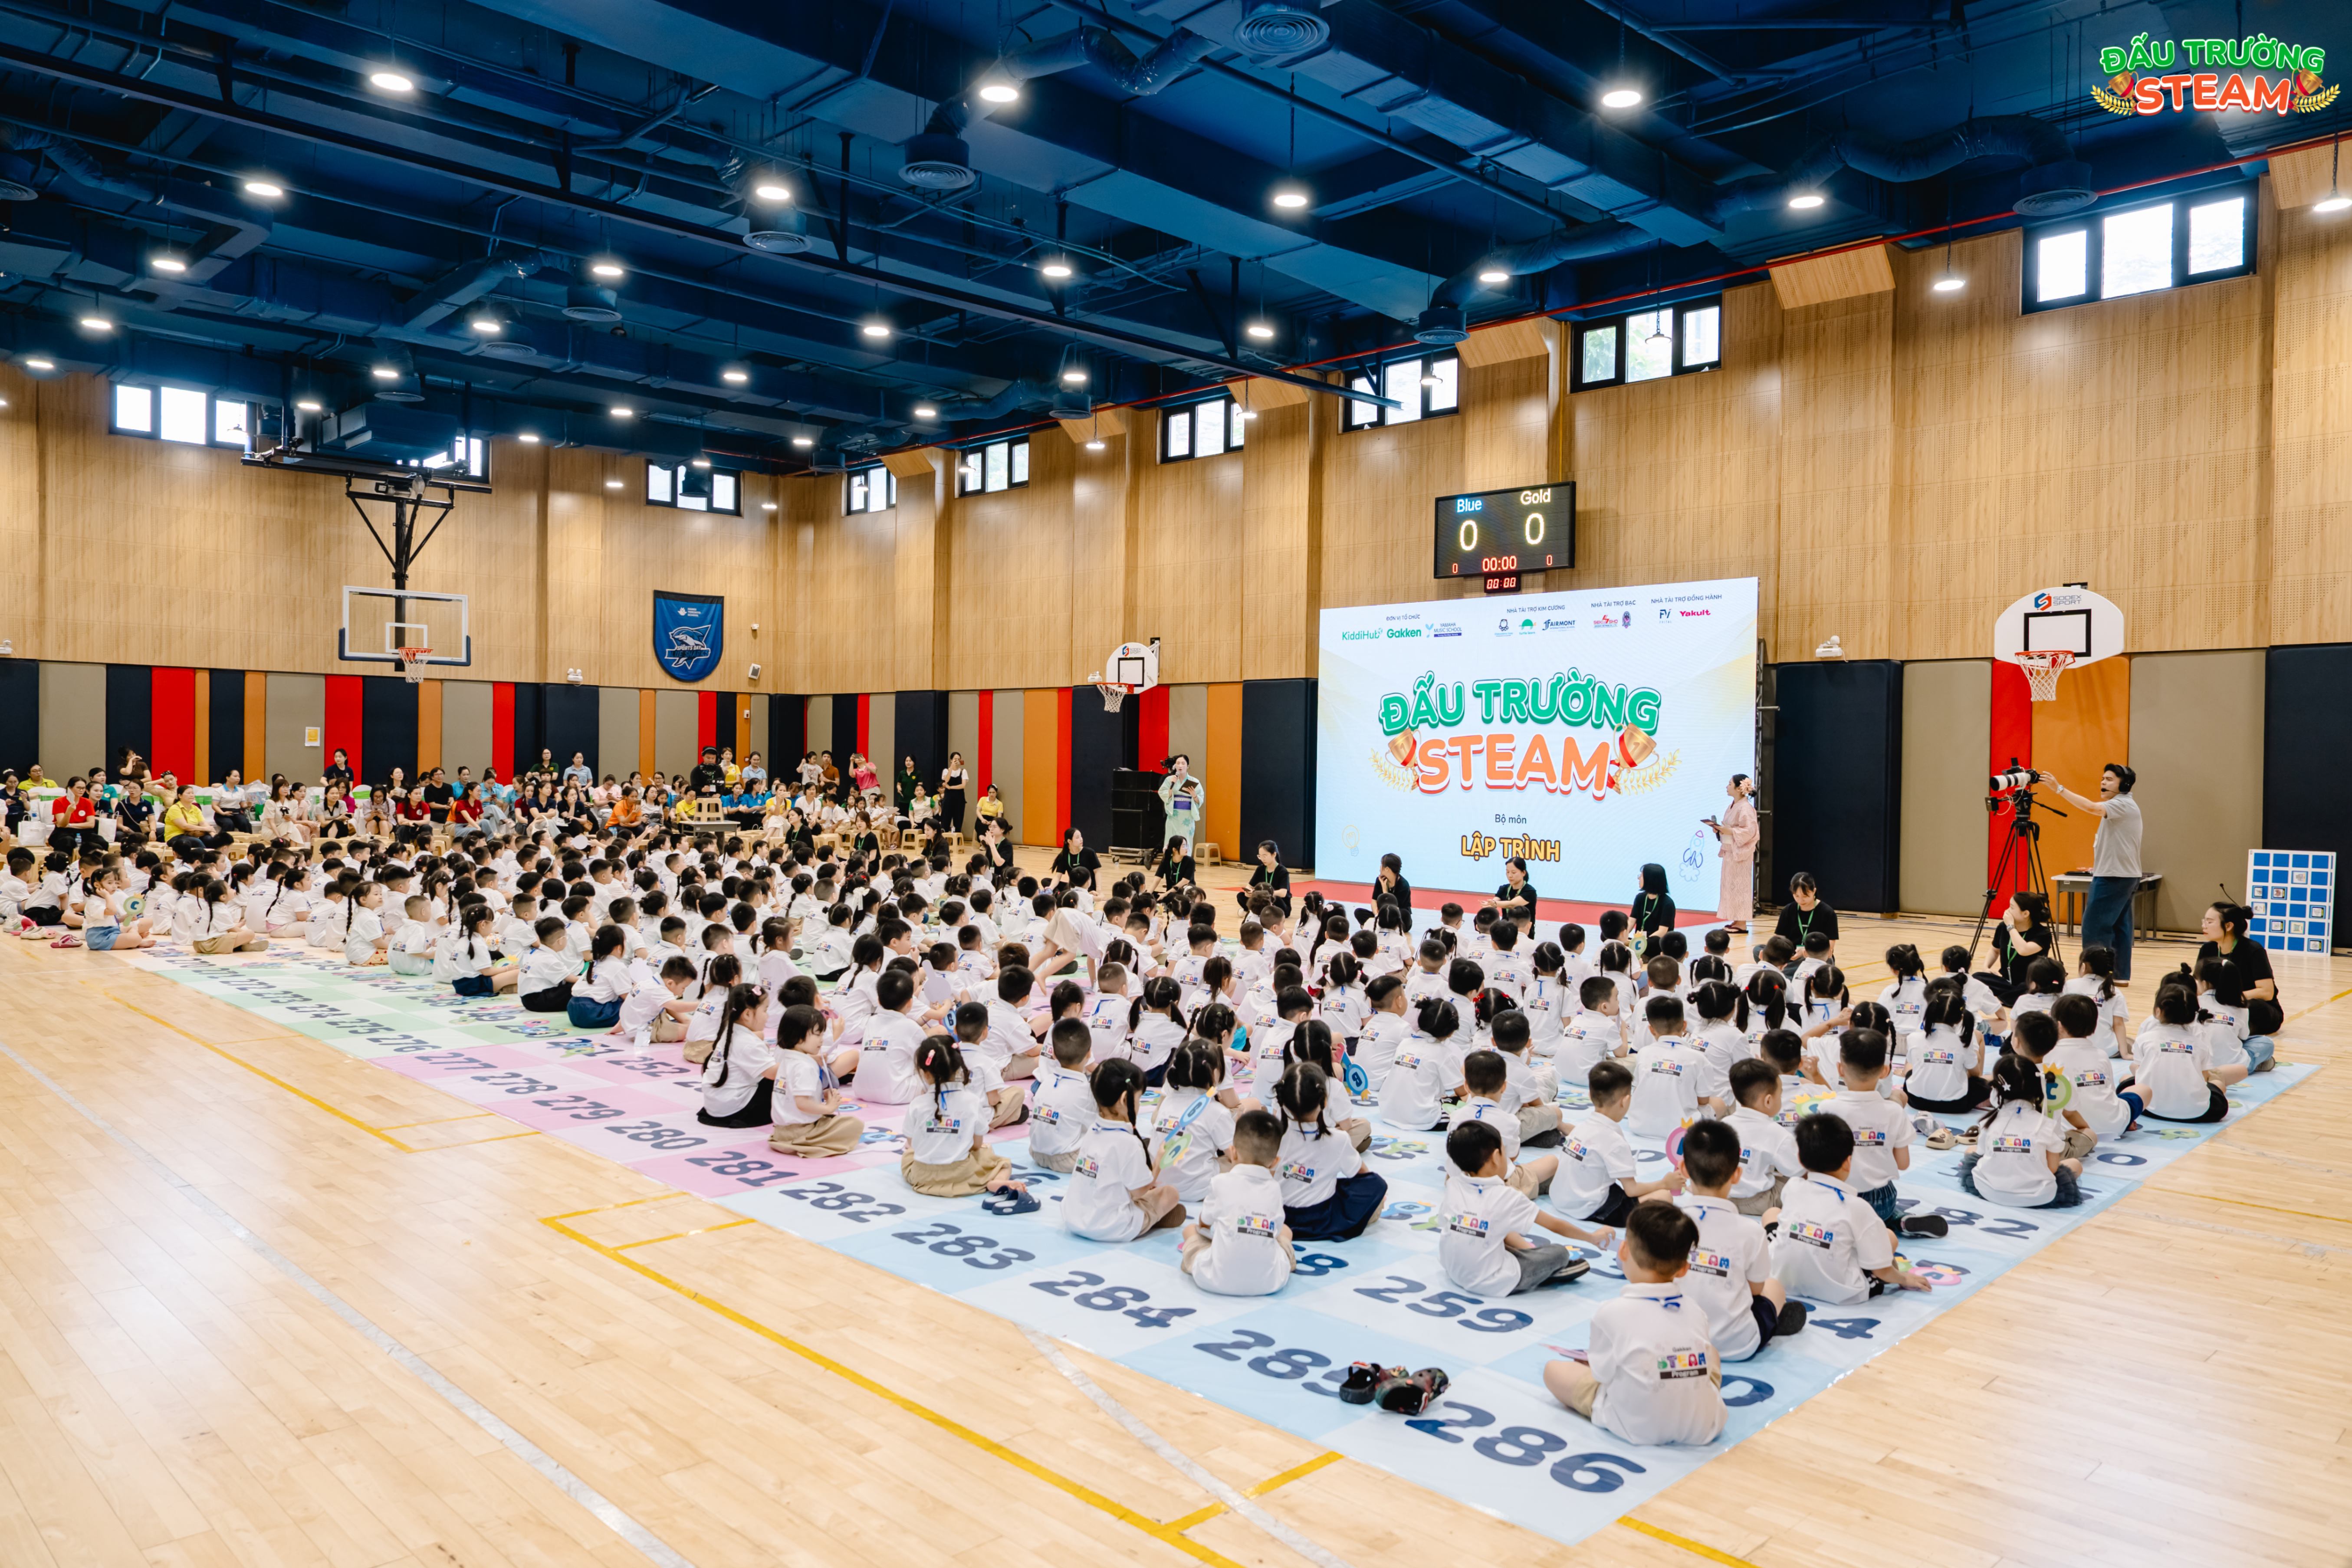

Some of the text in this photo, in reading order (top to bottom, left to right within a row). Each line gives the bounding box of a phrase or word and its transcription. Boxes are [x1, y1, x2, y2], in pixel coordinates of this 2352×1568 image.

[1521, 488, 1551, 505] Gold
[1457, 498, 1482, 513] Blue
[1460, 520, 1478, 551] 0
[1525, 513, 1544, 544] 0
[1482, 556, 1517, 571] 00:00
[1547, 555, 1552, 565] 0
[1452, 563, 1458, 573] 0
[1342, 629, 1381, 640] KiddiHub
[1387, 628, 1421, 638] Gakken
[1379, 667, 1661, 736] ĐẤU TRƯỜNG
[1415, 732, 1611, 801] STEAM
[1495, 814, 1527, 825] Bộ môn
[1461, 831, 1560, 862] LẬP TRÌNH
[131, 901, 139, 910] C
[1636, 940, 1642, 950] C
[165, 958, 216, 968] 270
[219, 979, 276, 991] 272
[252, 991, 312, 1003] 273
[286, 1004, 352, 1018] 274
[325, 1019, 396, 1034] 275
[366, 1035, 442, 1052] 276
[2160, 1042, 2193, 1050] STEAM
[414, 1052, 498, 1070] 277
[606, 1056, 690, 1077] 252
[1396, 1055, 1420, 1065] STEAM
[1652, 1061, 1682, 1071] STEAM
[470, 1072, 558, 1094] 278
[2075, 1073, 2106, 1082] STEAM
[2046, 1083, 2059, 1100] C
[532, 1095, 625, 1119] 279
[1034, 1106, 1059, 1120] STEAM
[1773, 1112, 1799, 1121] STEA
[604, 1121, 708, 1149] 280
[1853, 1131, 1886, 1140] TEAM
[1993, 1138, 2031, 1147] STEAM
[685, 1151, 799, 1187] 281
[779, 1183, 906, 1222] 282
[1237, 1216, 1275, 1231] STEAM
[1451, 1215, 1488, 1231] STEAM
[1247, 1228, 1268, 1237] Program
[1456, 1226, 1477, 1236] Program
[1790, 1220, 1833, 1242] STEAM
[891, 1223, 1035, 1269] 283
[1797, 1234, 1820, 1247] Program
[1687, 1251, 1729, 1269] TEAM
[1029, 1271, 1197, 1327] 284
[1353, 1275, 1533, 1332] 259
[1657, 1352, 1706, 1370] STEAM
[1405, 1401, 1646, 1493] 286
